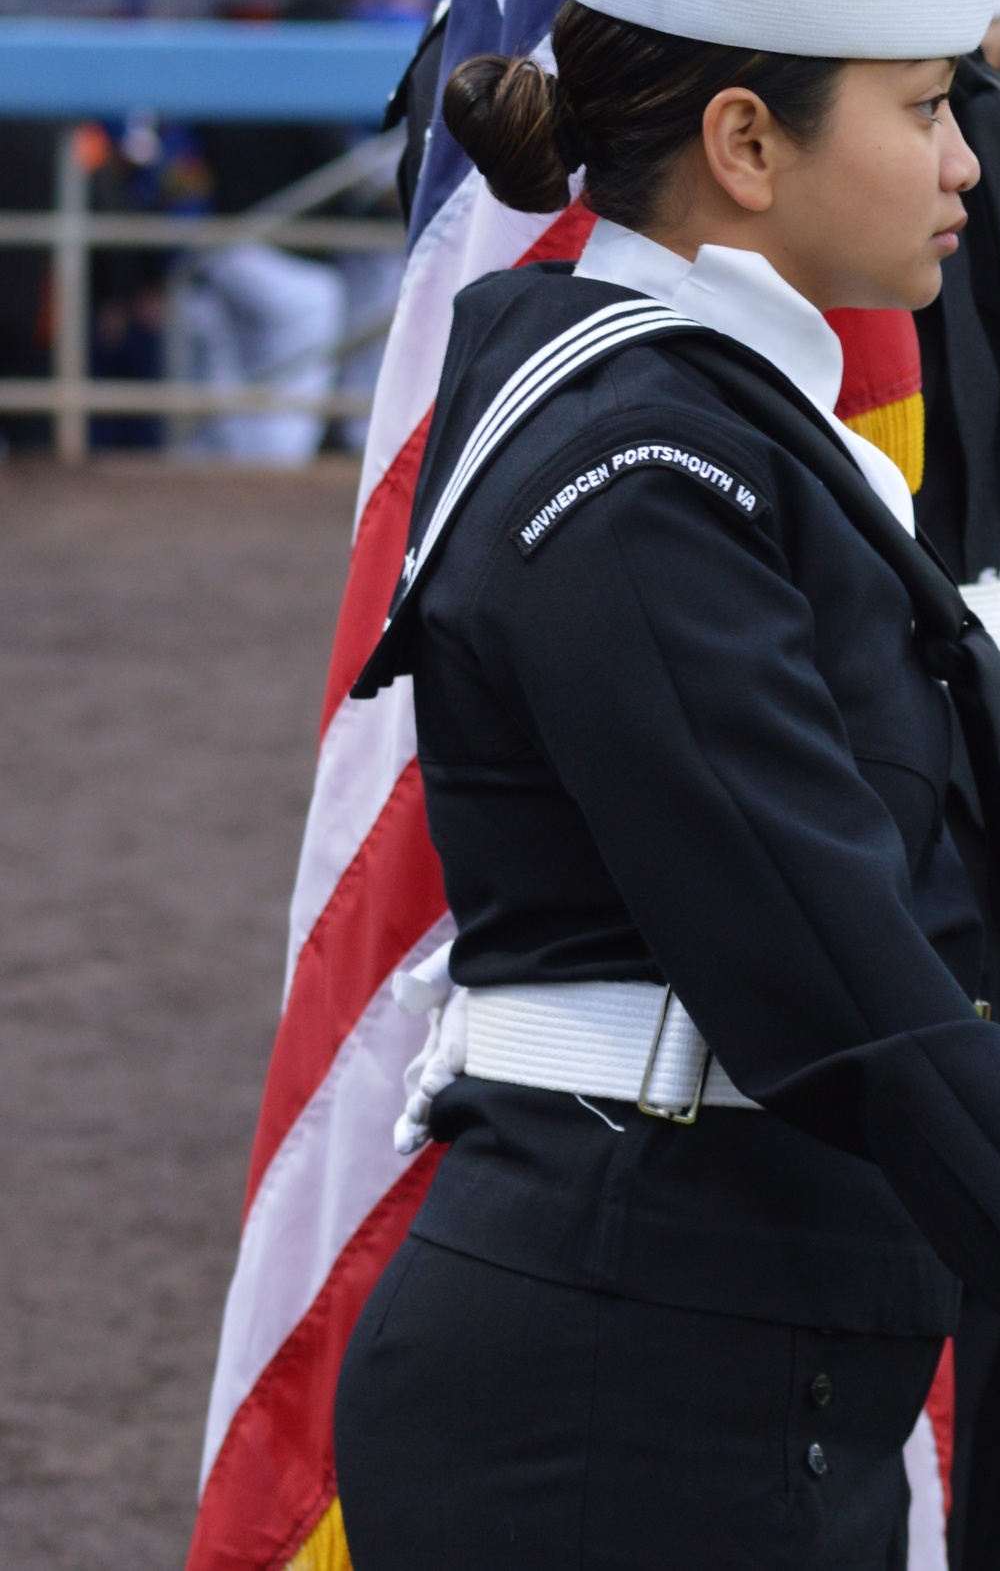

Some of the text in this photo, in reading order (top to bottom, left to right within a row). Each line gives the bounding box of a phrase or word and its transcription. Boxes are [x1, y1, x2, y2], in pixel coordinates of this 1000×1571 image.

[520, 445, 756, 545] NAVMEDCEN PORTSMOUTH VA
